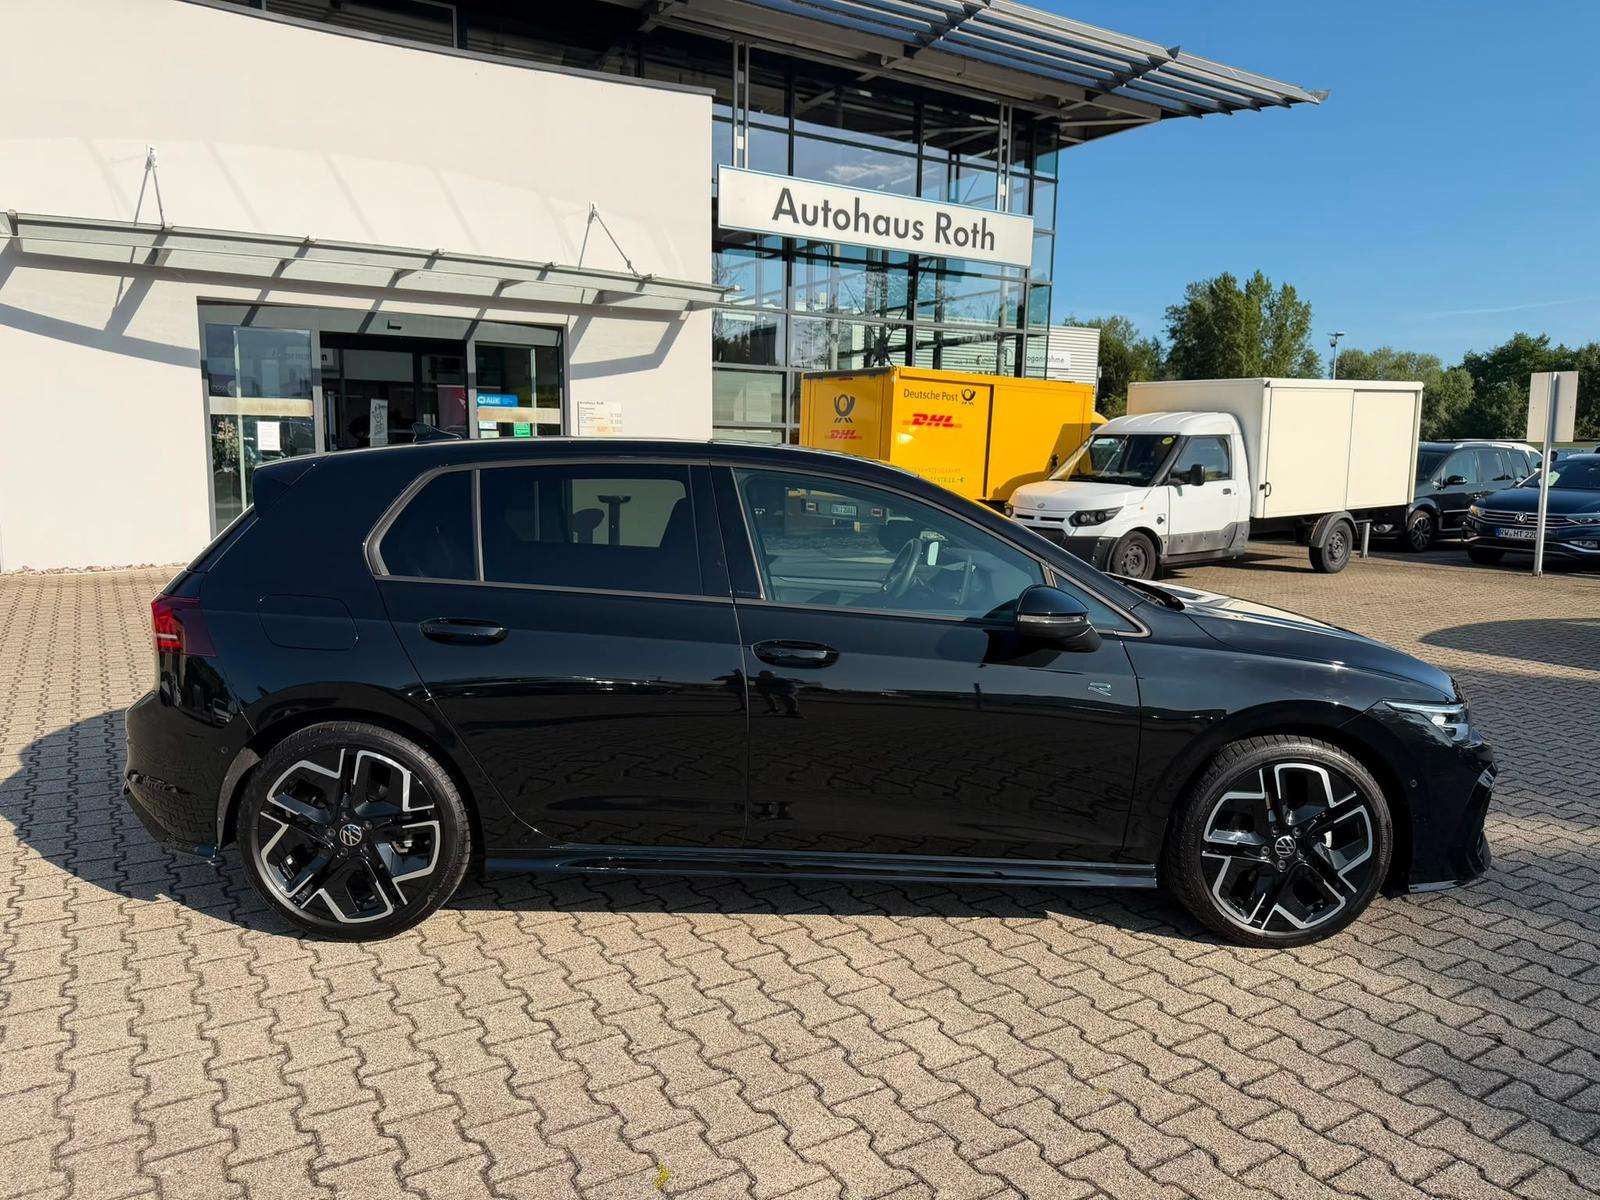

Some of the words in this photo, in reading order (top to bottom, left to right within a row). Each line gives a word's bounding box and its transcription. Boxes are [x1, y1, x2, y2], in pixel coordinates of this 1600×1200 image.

[772, 187, 924, 241] Autohaus
[935, 211, 995, 251] Roth
[903, 388, 940, 401] Deutsche
[941, 392, 958, 402] Post
[911, 413, 955, 428] DHL
[830, 429, 857, 440] DHL
